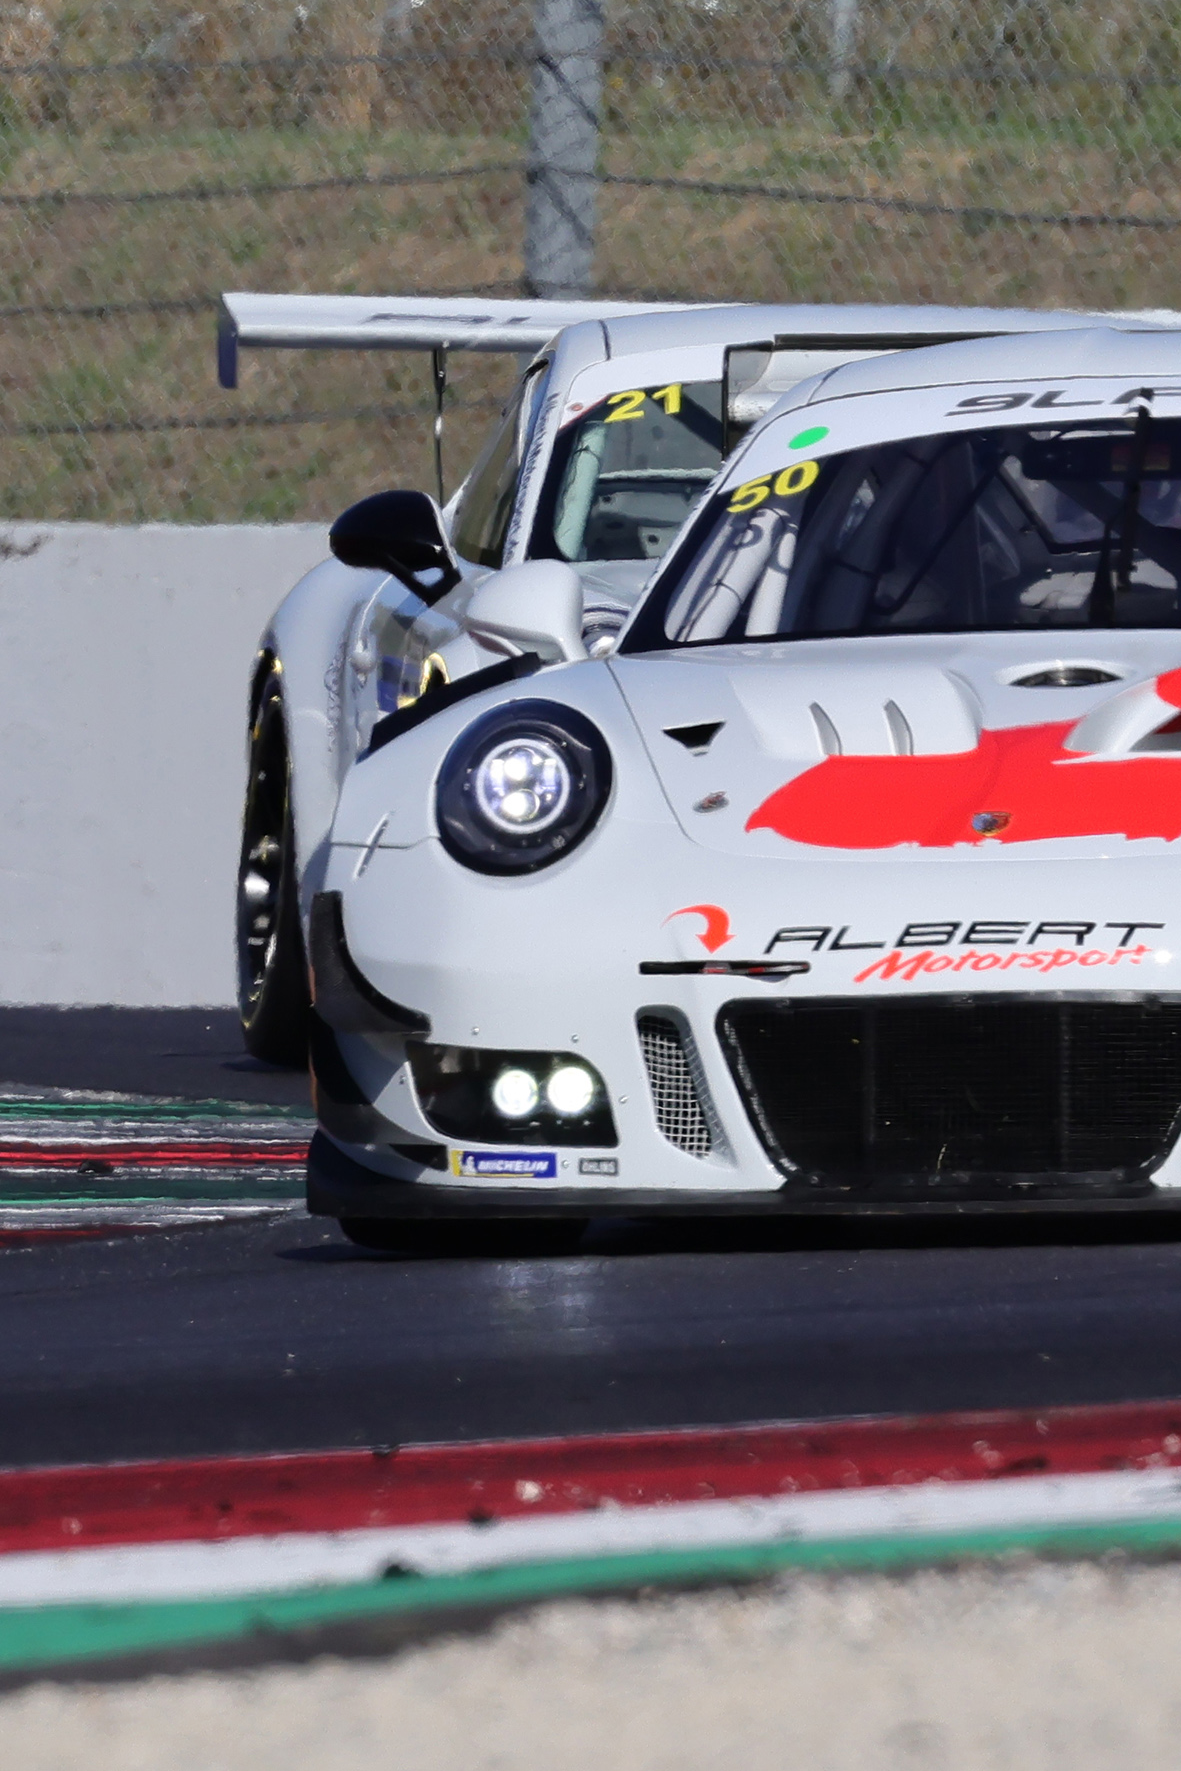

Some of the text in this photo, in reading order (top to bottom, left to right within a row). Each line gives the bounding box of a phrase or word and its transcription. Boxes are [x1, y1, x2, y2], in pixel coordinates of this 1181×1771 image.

[603, 383, 682, 424] 21
[726, 460, 820, 513] 50
[764, 921, 1166, 954] ALBERT
[853, 944, 1153, 983] Motorsport
[477, 1159, 549, 1173] MICHELIN
